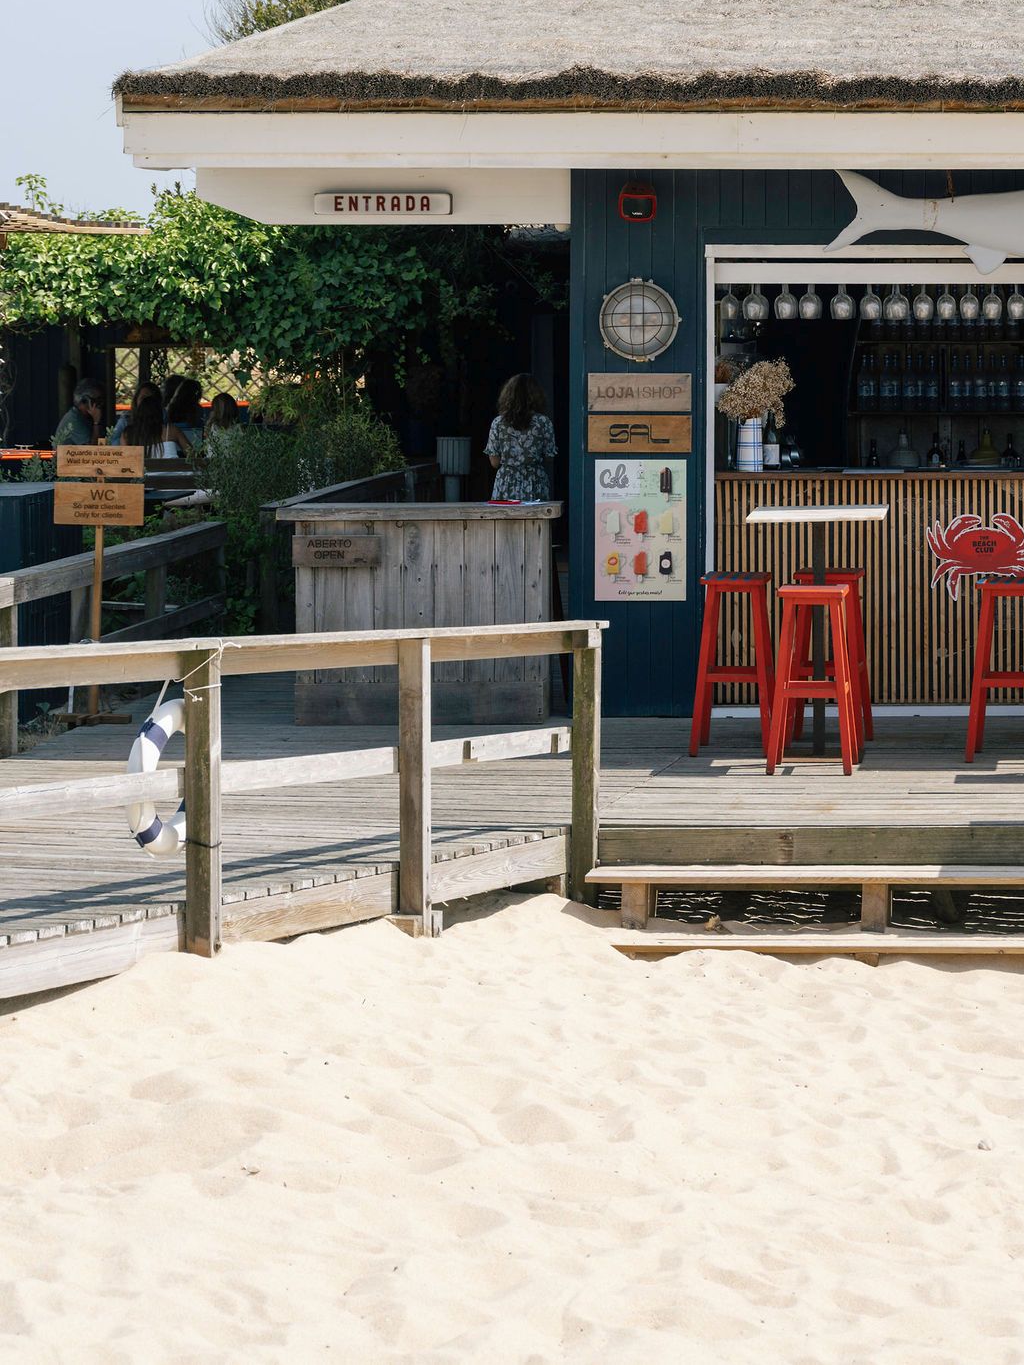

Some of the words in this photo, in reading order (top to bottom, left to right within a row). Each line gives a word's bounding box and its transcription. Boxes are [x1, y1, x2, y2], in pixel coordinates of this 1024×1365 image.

[334, 195, 431, 212] ENTRADA
[597, 386, 634, 399] LOJA
[642, 386, 682, 399] SHOP
[609, 423, 670, 444] SAL
[66, 449, 92, 457] Aguarde
[90, 489, 115, 501] WC
[74, 511, 90, 519] Only
[307, 539, 352, 548] ABERTO
[314, 550, 345, 560] OPEN
